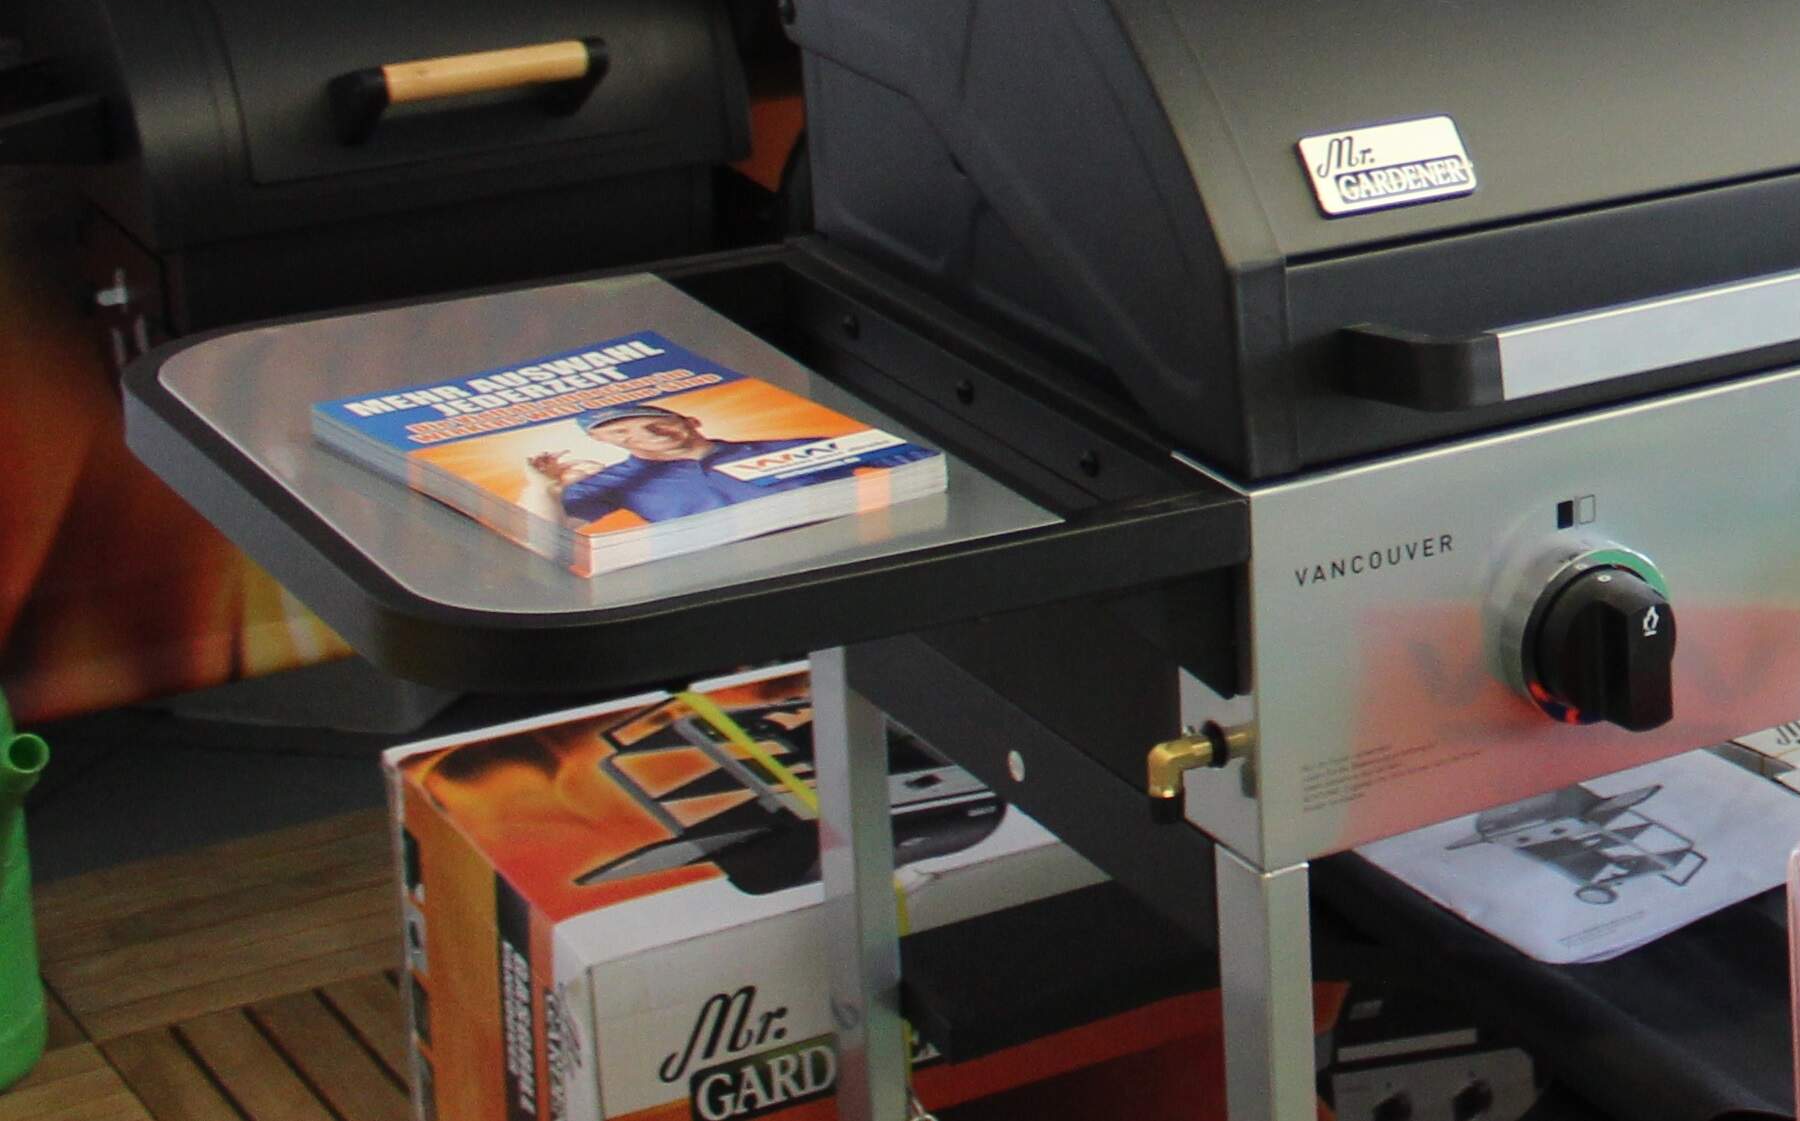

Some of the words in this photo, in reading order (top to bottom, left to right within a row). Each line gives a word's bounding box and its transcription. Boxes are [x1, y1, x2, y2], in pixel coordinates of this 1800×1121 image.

[1317, 135, 1376, 178] Mr.
[1337, 157, 1470, 201] GARDENER
[344, 383, 471, 417] MEHR
[467, 340, 666, 395] AUSWAHL
[432, 366, 630, 418] JEDERZEIT
[1295, 534, 1453, 587] VANCOUVER
[659, 984, 788, 1084] Mr.
